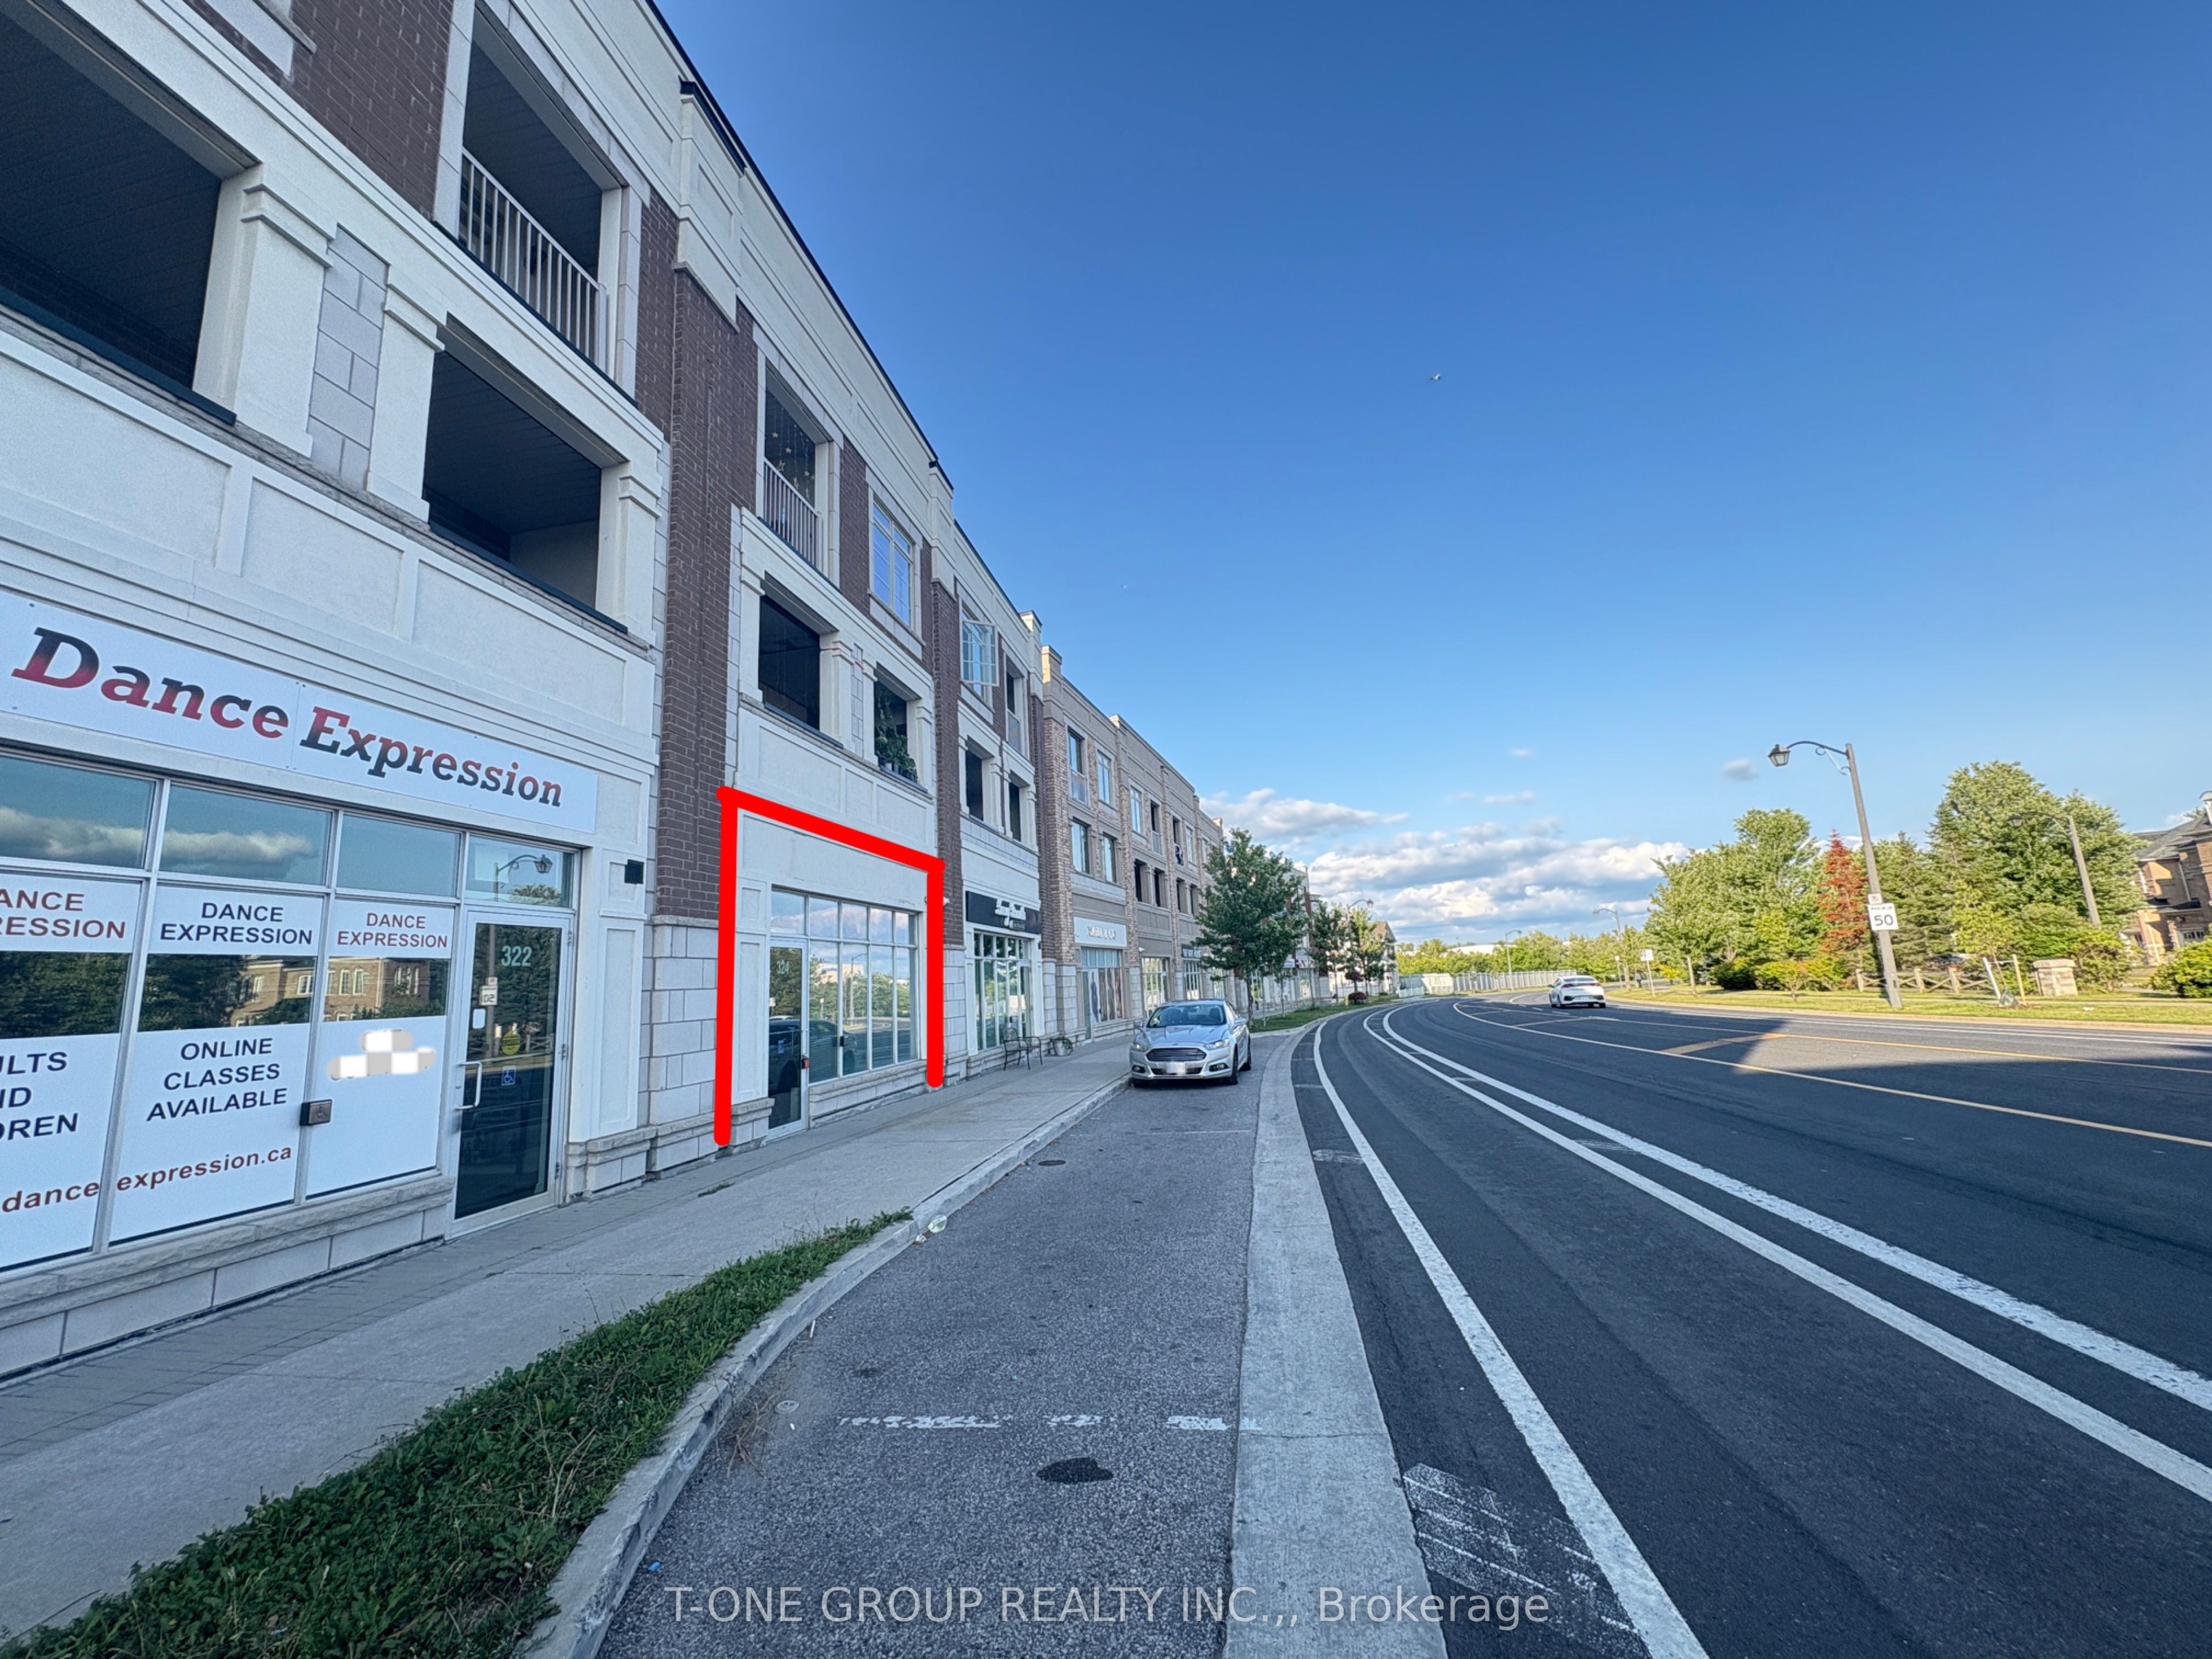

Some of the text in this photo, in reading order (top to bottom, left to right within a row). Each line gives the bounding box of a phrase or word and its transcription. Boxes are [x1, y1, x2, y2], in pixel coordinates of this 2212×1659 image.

[11, 627, 563, 808] Dance Expression
[201, 903, 284, 922] DANCE
[366, 912, 426, 929] DANCE
[1874, 914, 1893, 926] 50
[0, 916, 126, 938] ESSION
[160, 924, 312, 945] EXPRESSION
[337, 931, 448, 948] EXPRESSION
[501, 945, 532, 967] 322
[180, 1038, 273, 1060] ONLINE
[164, 1064, 280, 1090] CLASSES
[147, 1088, 287, 1121] AVAILABLE
[0, 1112, 78, 1141] REN
